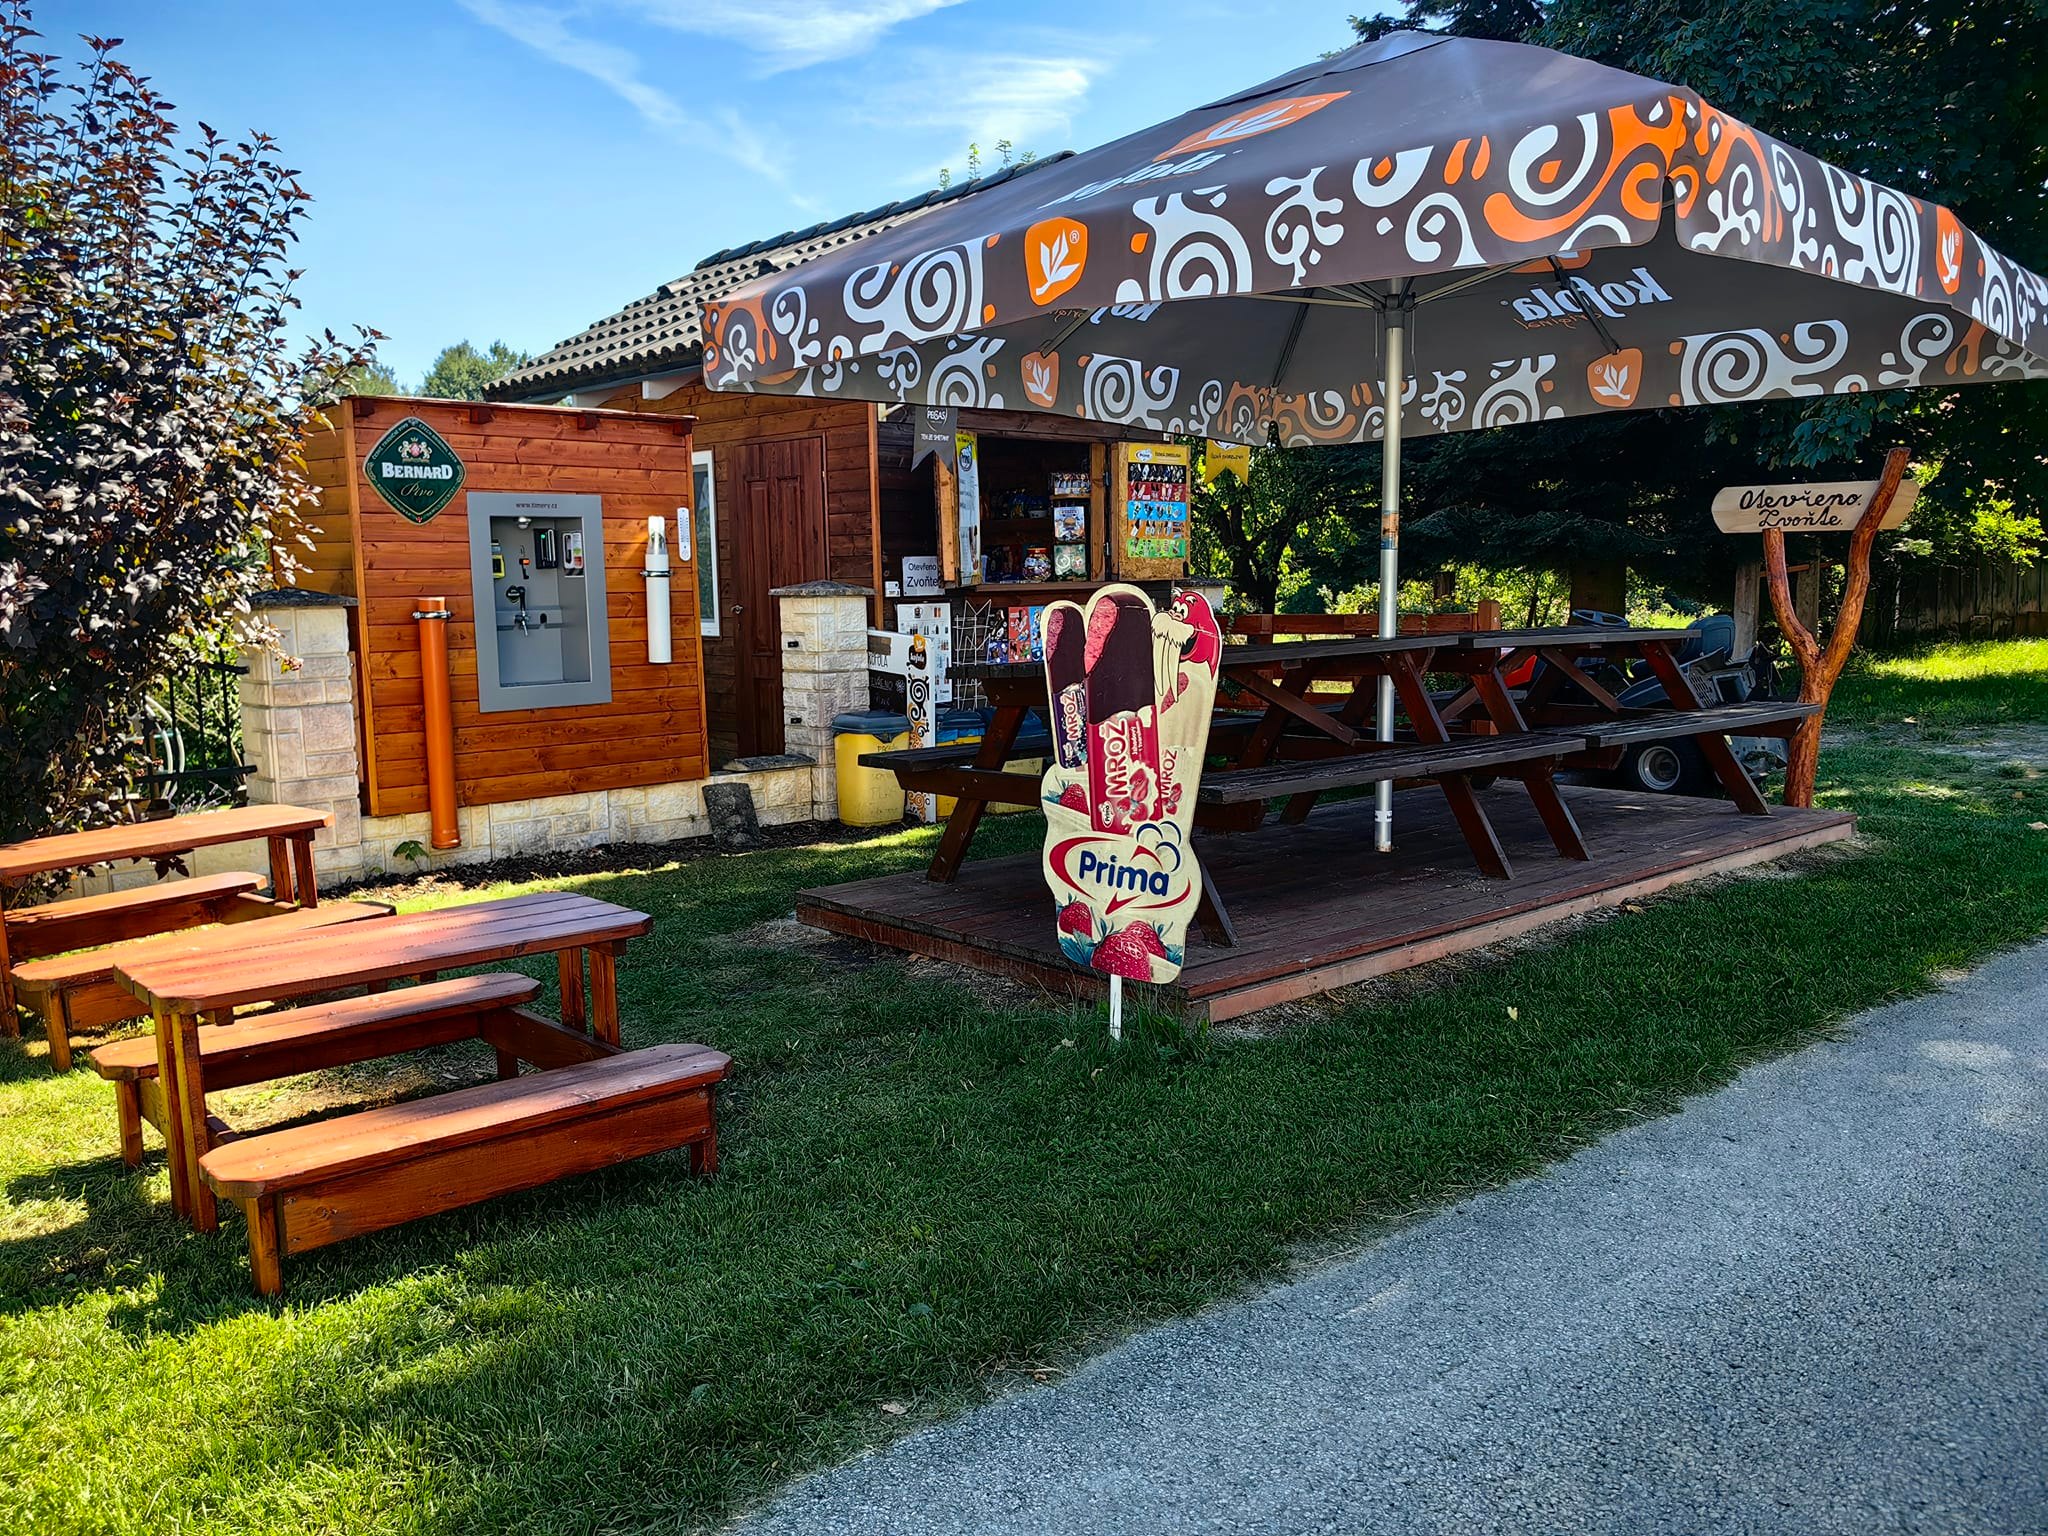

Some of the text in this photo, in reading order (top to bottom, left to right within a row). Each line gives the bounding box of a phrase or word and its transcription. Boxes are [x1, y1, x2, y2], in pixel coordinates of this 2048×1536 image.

[381, 462, 454, 480] BERNARD
[401, 480, 434, 497] Pivo
[906, 576, 939, 588] Zvoňte
[908, 562, 937, 571] Otevřeno
[1060, 691, 1079, 741] MROŽ
[1098, 717, 1130, 798] MROŽ
[1161, 749, 1178, 799] MROŽ
[1078, 850, 1170, 897] Prima
